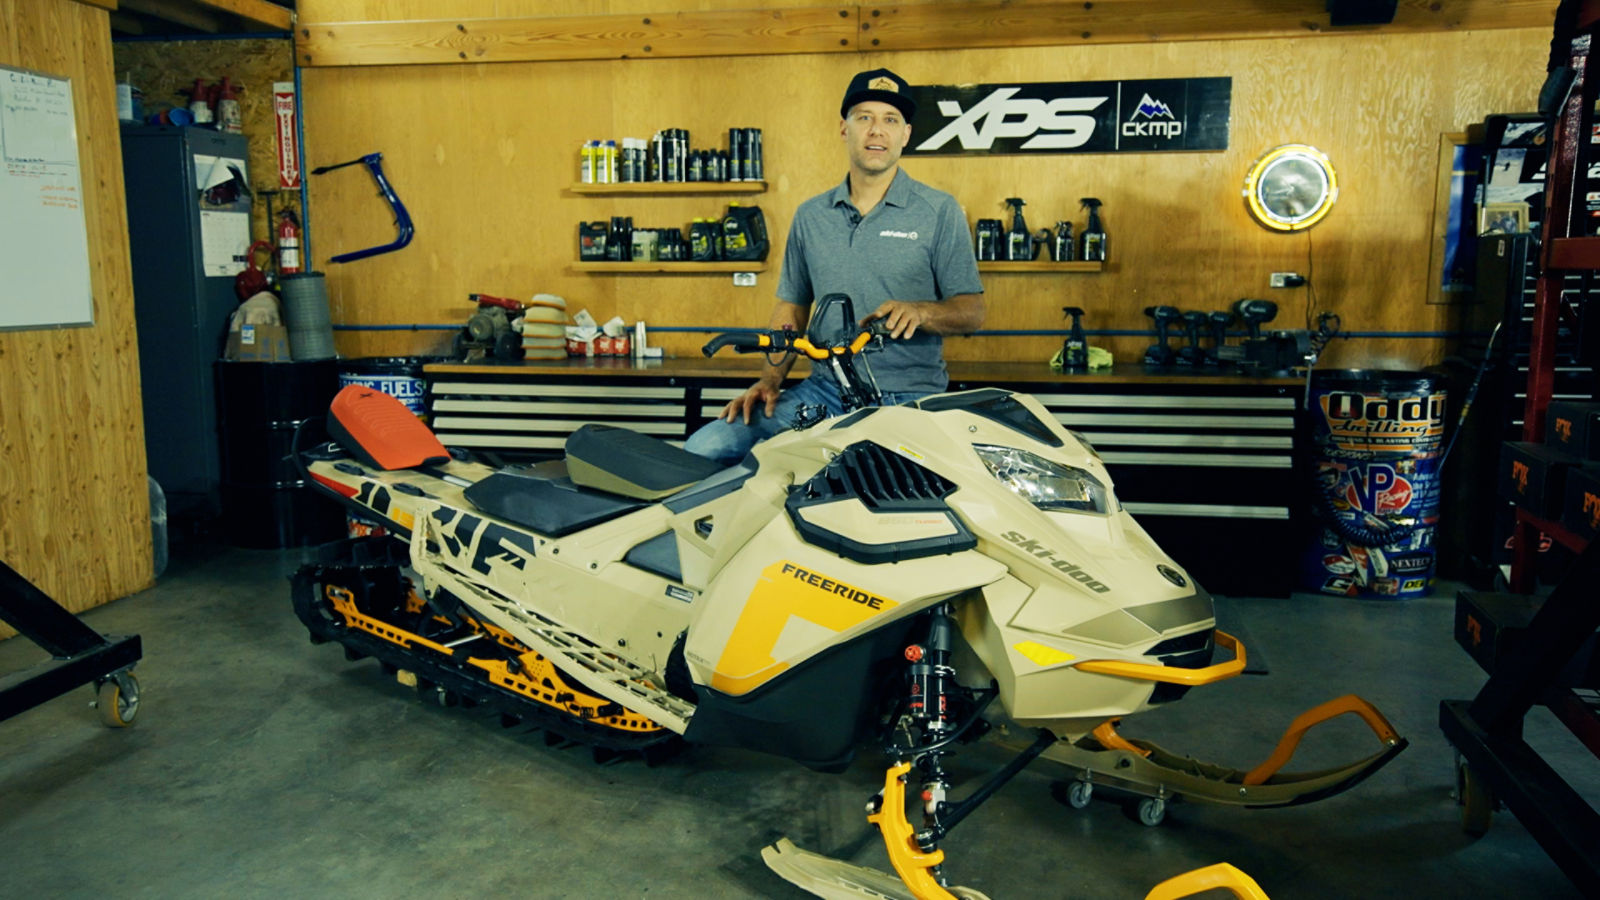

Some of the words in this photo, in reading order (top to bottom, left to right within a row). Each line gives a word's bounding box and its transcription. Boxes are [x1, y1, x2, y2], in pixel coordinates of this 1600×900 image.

[277, 101, 292, 110] FIRE
[915, 87, 1109, 150] XPS
[283, 113, 293, 180] EXTINGUISHER
[381, 381, 424, 397] FUELS
[1347, 463, 1396, 515] VP
[781, 563, 884, 610] FREERIDE
